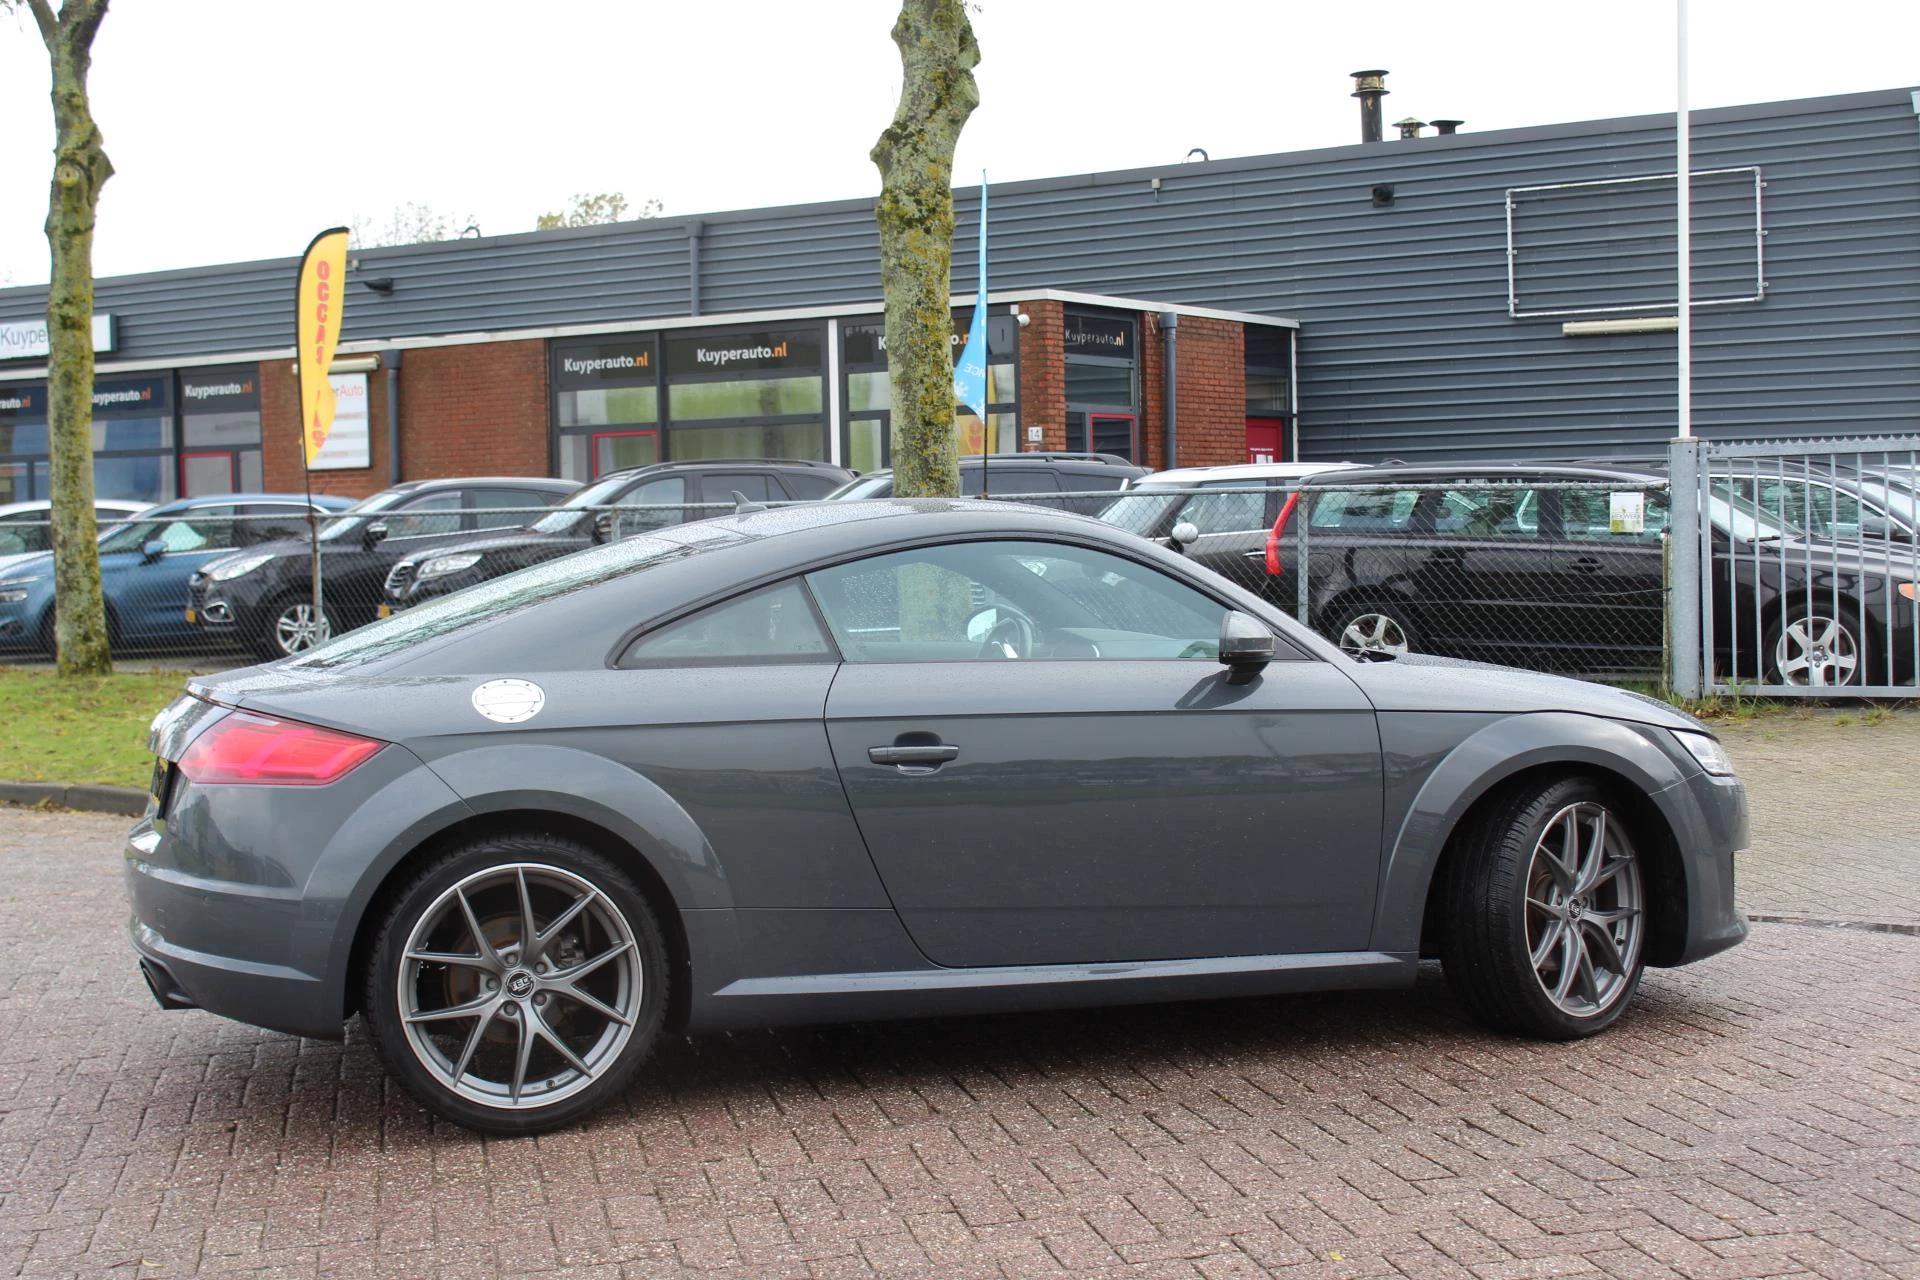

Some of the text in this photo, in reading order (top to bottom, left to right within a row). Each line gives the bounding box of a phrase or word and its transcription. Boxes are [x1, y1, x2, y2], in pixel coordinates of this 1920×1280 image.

[1065, 329, 1125, 346] Kuyperauto.nl
[564, 352, 648, 374] Kuyperauto.nl
[697, 342, 787, 366] Kuyperauto.nl
[91, 387, 152, 405] uyperauto.nl
[185, 381, 253, 399] Kuyperauto.nl
